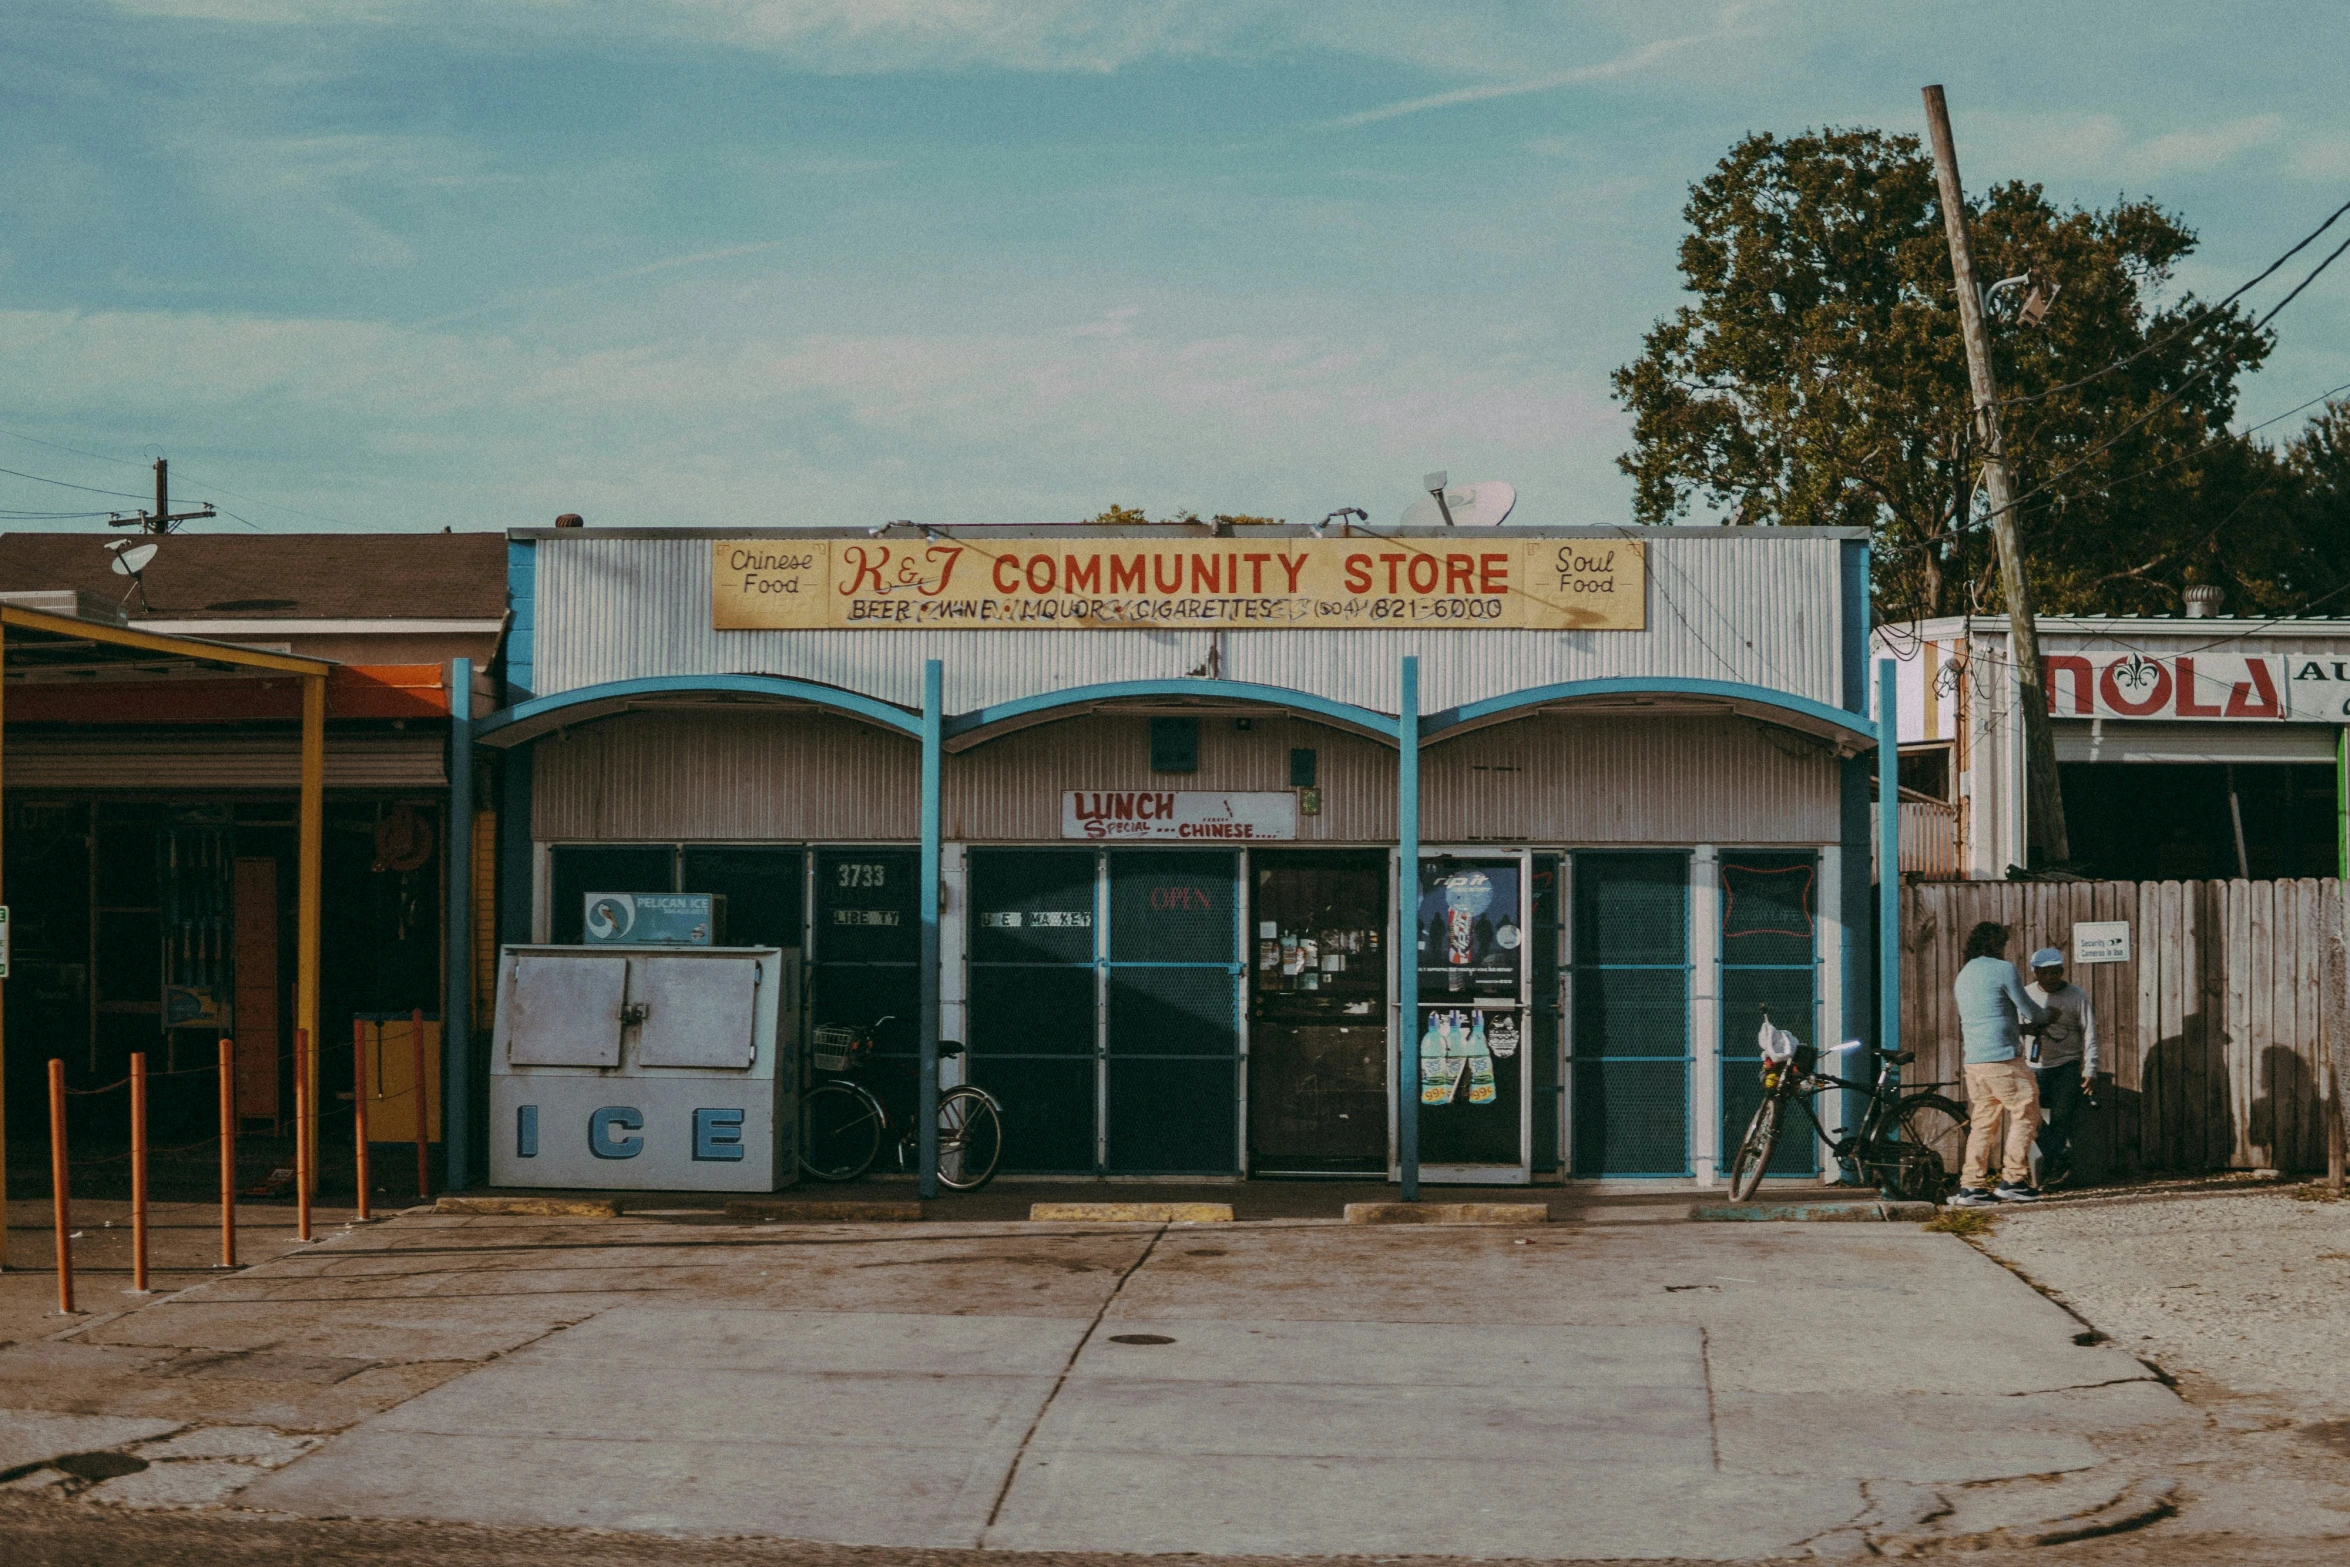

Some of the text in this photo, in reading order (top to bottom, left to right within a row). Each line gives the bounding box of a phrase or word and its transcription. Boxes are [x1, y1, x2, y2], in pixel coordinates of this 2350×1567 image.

[731, 549, 813, 570] Chinese
[1556, 546, 1615, 573] Soul
[744, 573, 800, 593] Food
[993, 553, 1309, 595] COMMUNITY
[1344, 553, 1509, 595] STORE
[1560, 574, 1615, 593] Food
[1375, 598, 1502, 619] 821-6000
[1075, 792, 1174, 820] LUNCH
[838, 863, 885, 887] 3733
[636, 897, 708, 909] PELICAN ICE
